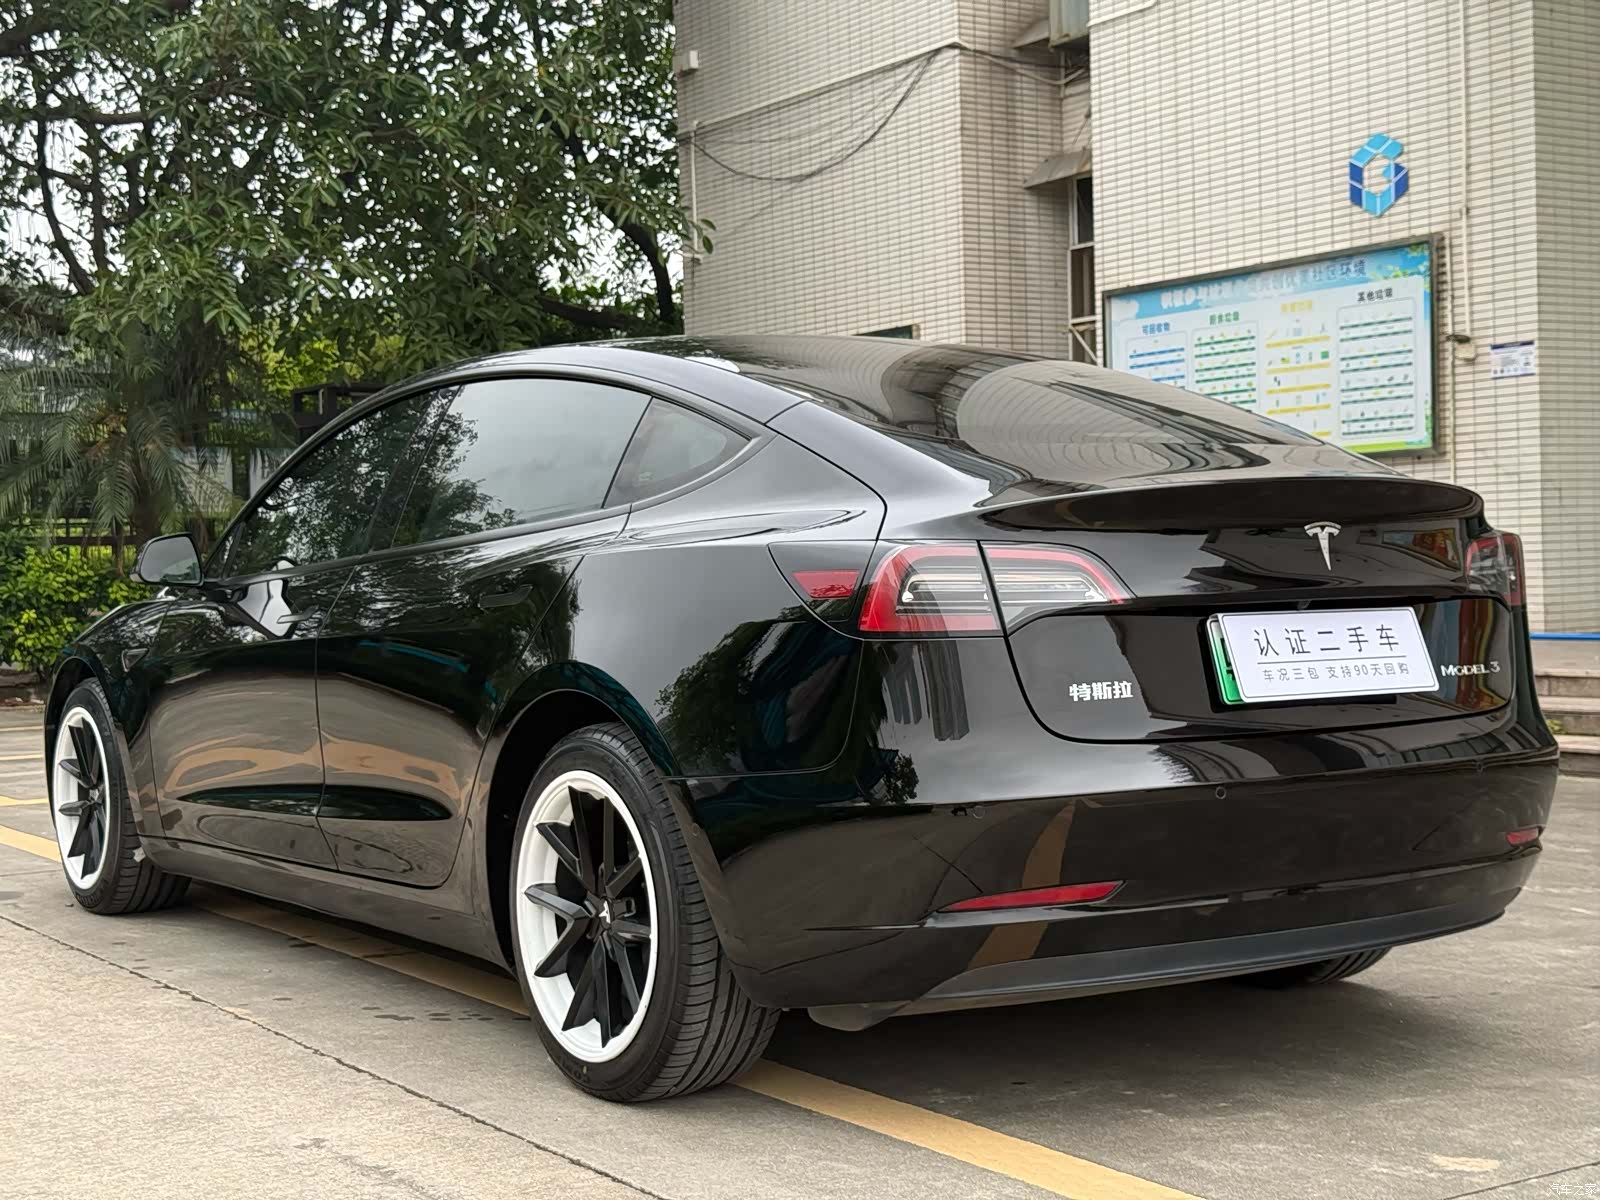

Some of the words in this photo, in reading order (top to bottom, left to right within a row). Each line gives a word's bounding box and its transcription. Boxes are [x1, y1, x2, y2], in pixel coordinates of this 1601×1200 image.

[1253, 624, 1399, 656] 认证二手车
[1262, 667, 1320, 682] 车况三包
[1326, 663, 1409, 679] 支持90天回购
[1440, 664, 1490, 676] MODEL
[1490, 661, 1500, 673] 3
[1069, 681, 1134, 702] 特斯拉
